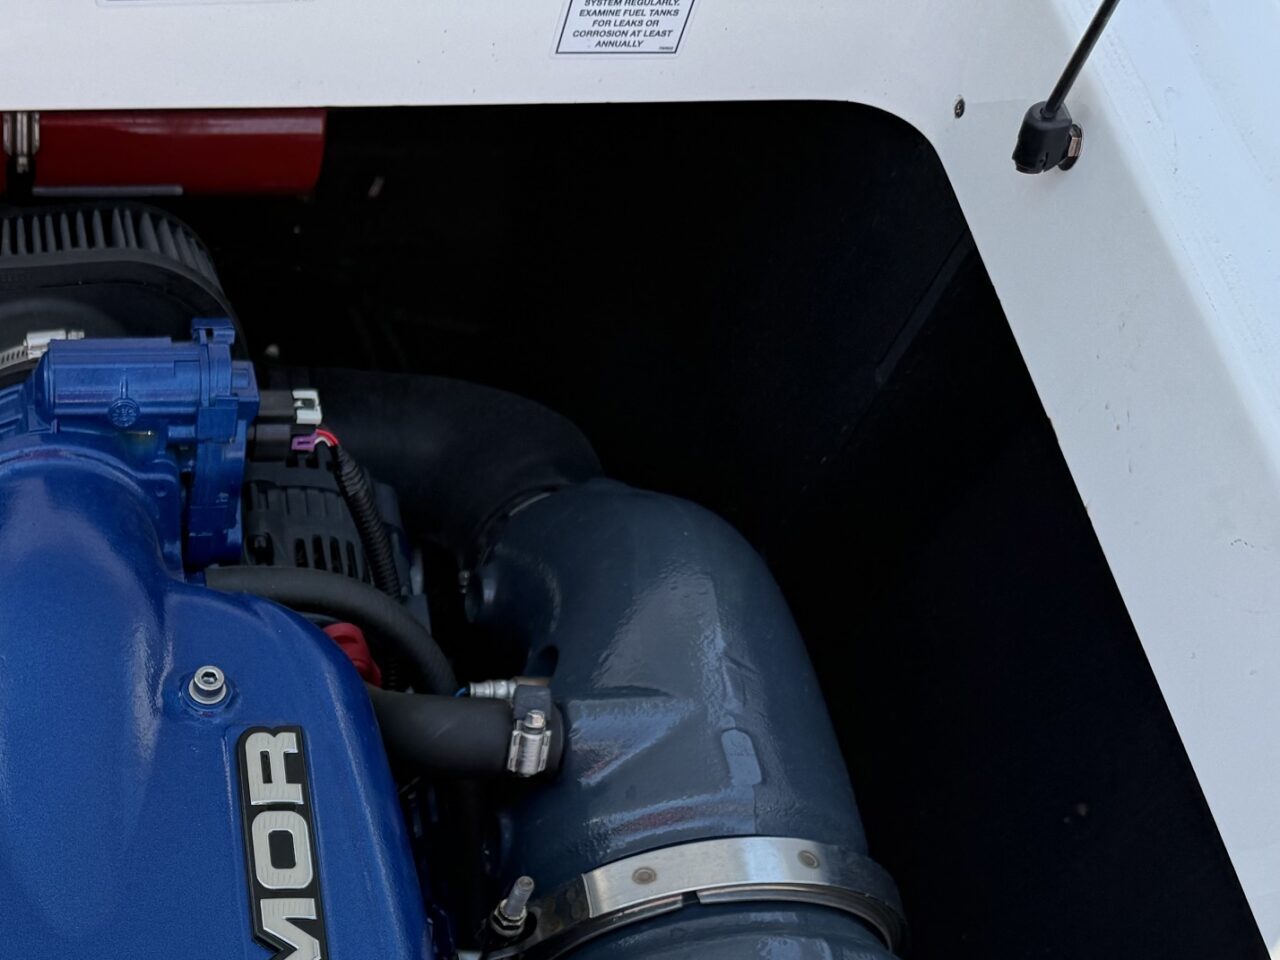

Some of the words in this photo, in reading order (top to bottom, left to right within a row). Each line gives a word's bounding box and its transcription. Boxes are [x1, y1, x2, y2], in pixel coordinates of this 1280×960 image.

[579, 9, 620, 17] EXAMINE
[623, 9, 646, 17] FUEL
[649, 9, 680, 17] TANKS
[594, 40, 644, 48] ANNUALLY
